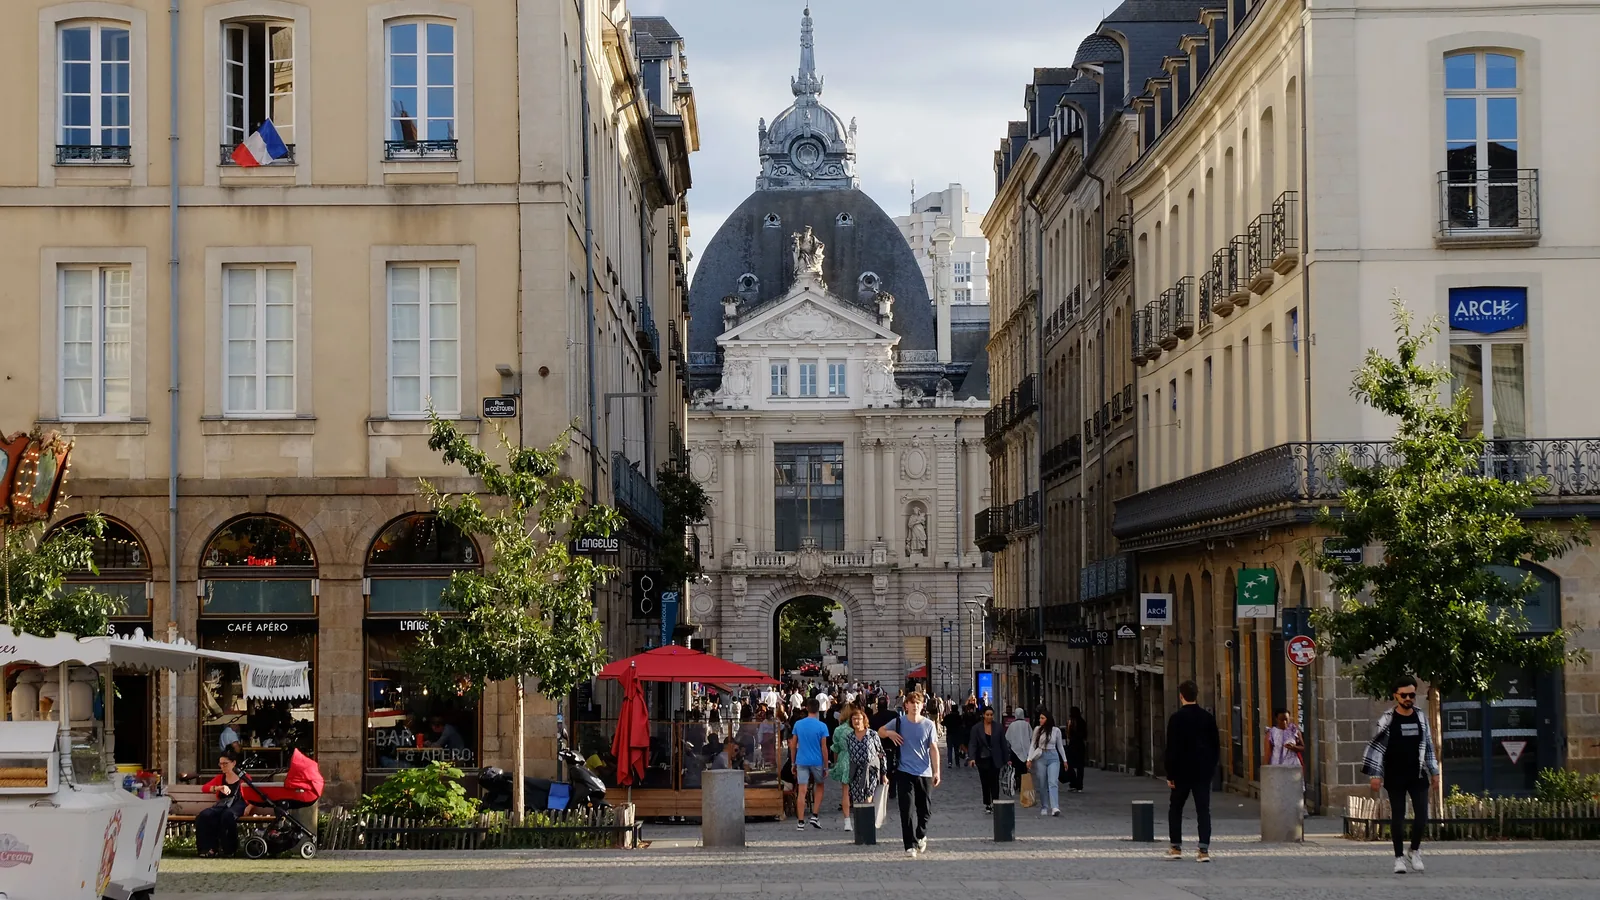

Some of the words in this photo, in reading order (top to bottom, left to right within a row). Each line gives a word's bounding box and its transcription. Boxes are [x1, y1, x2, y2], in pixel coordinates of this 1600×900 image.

[227, 621, 252, 632] CAFÉ
[256, 621, 288, 632] APÉRO
[376, 730, 413, 746] BAR
[405, 749, 415, 761] &
[0, 851, 32, 863] Cream
